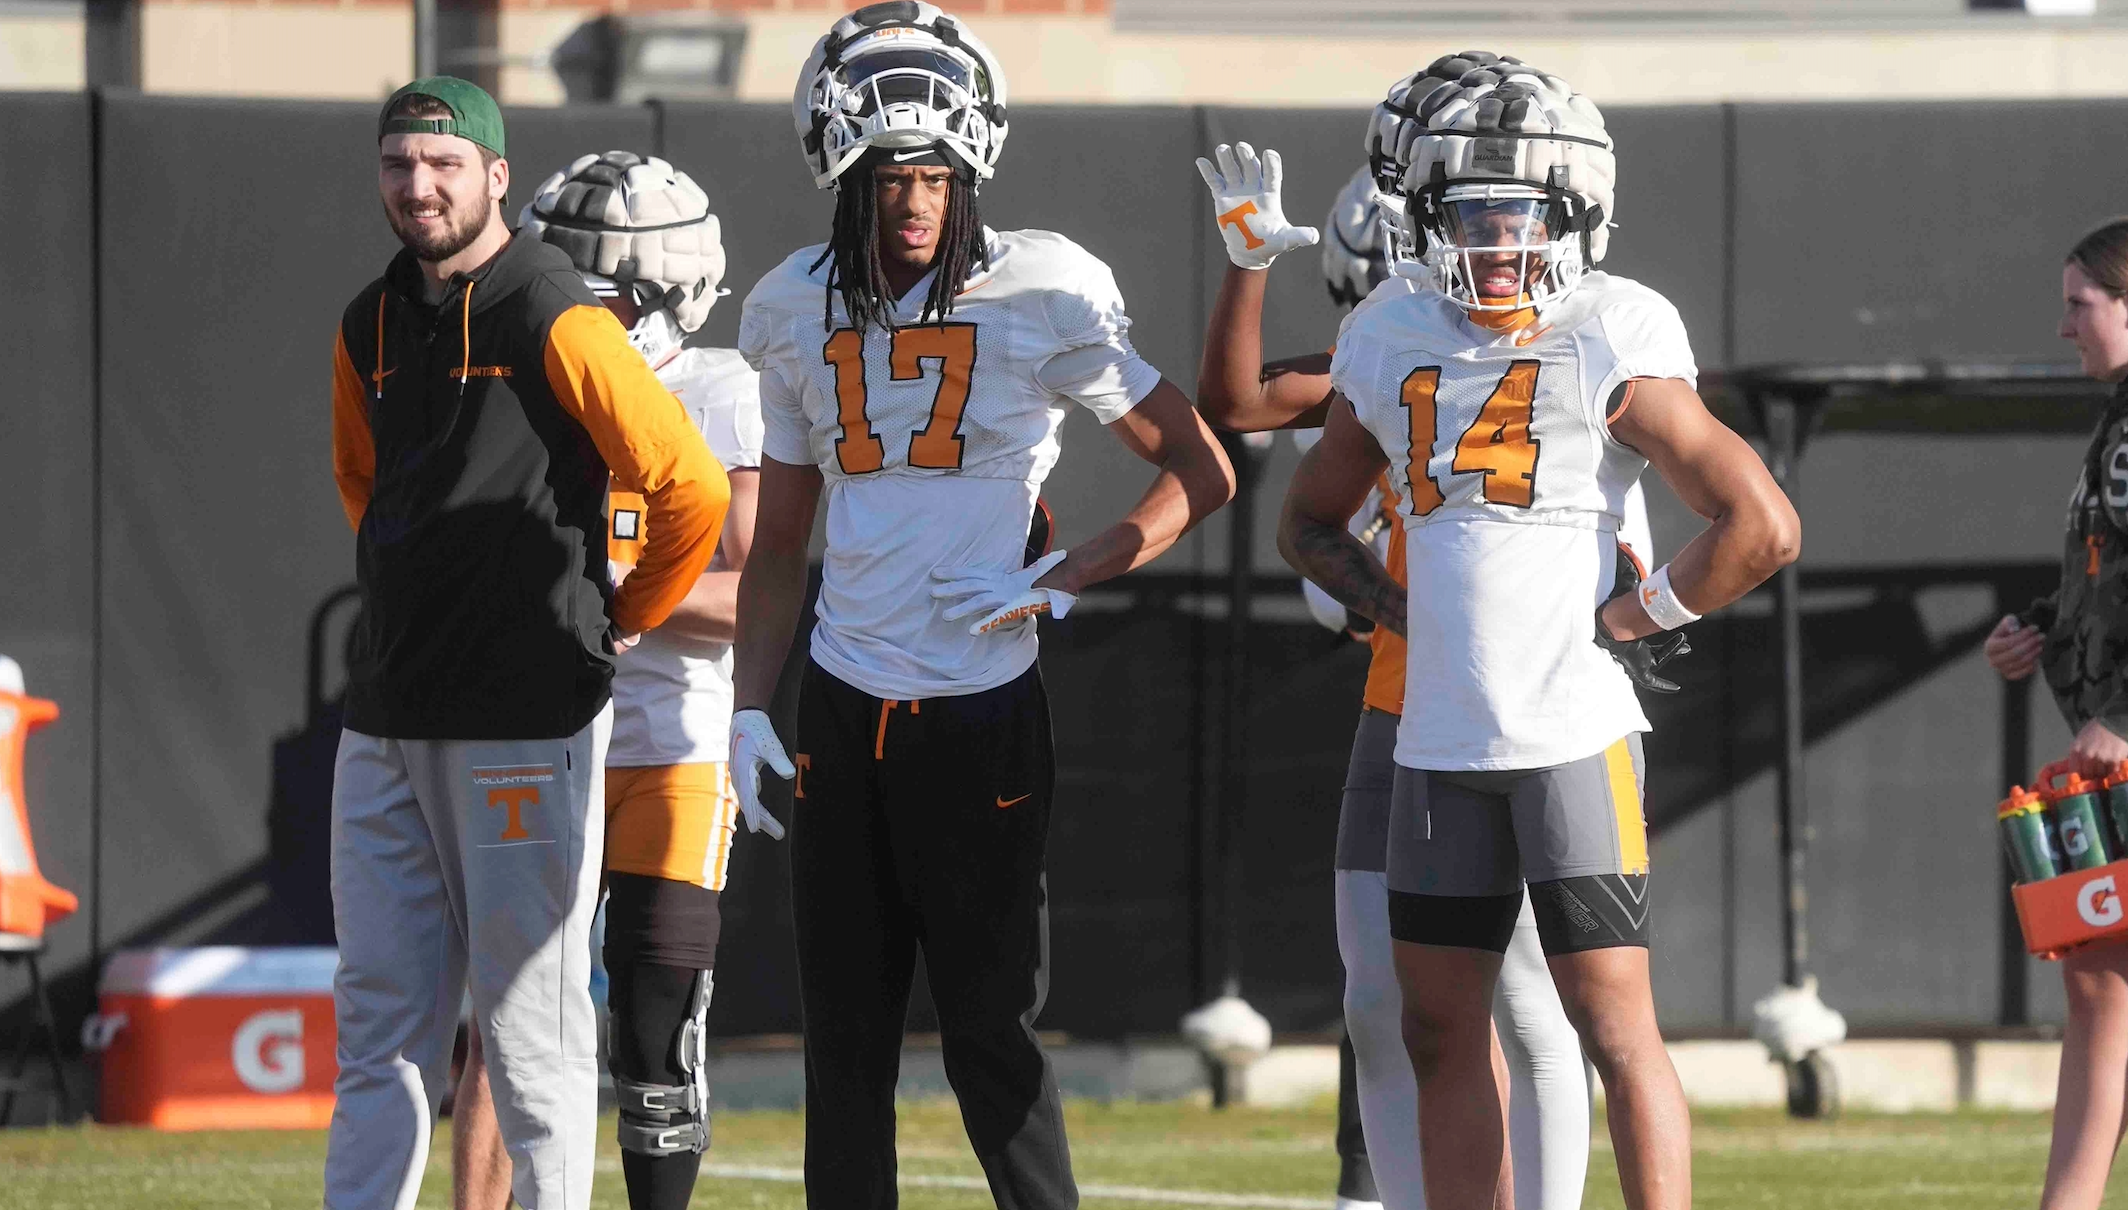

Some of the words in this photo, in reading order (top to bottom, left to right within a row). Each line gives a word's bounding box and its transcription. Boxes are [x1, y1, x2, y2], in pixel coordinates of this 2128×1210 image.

[1474, 154, 1513, 162] GUARDIAN
[1217, 200, 1266, 250] T
[450, 366, 512, 378] VOUNTEERS
[823, 322, 978, 474] 17
[1399, 359, 1541, 516] 14
[1643, 587, 1659, 606] T
[473, 774, 554, 785] VOLUNTEERS
[486, 786, 539, 840] T
[2060, 816, 2089, 856] G
[2077, 876, 2124, 927] G
[232, 1009, 306, 1093] G
